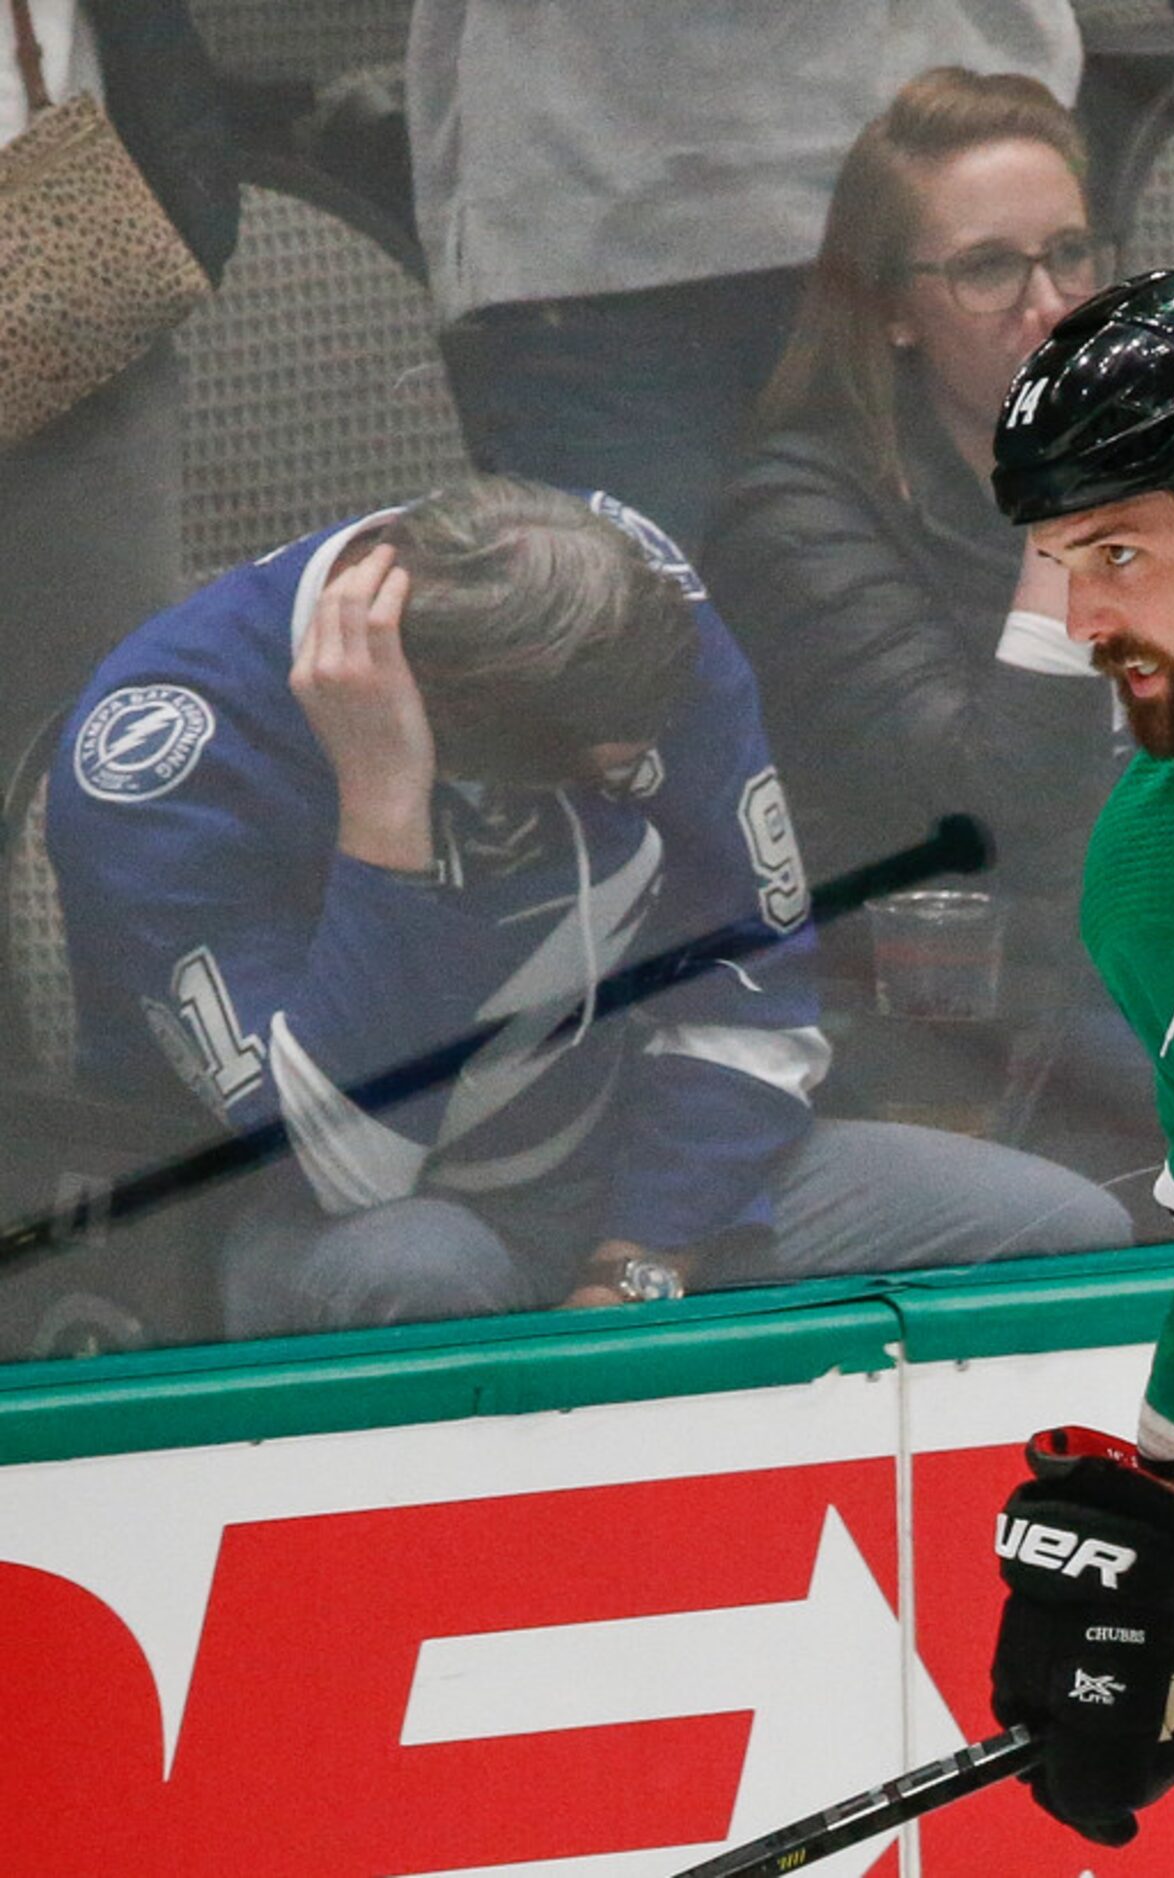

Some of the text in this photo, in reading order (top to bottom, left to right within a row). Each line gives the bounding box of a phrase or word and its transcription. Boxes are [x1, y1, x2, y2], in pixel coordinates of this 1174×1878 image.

[1006, 376, 1049, 429] 14
[82, 700, 123, 761] TAMPA
[1085, 1627, 1145, 1644] CHUBBS
